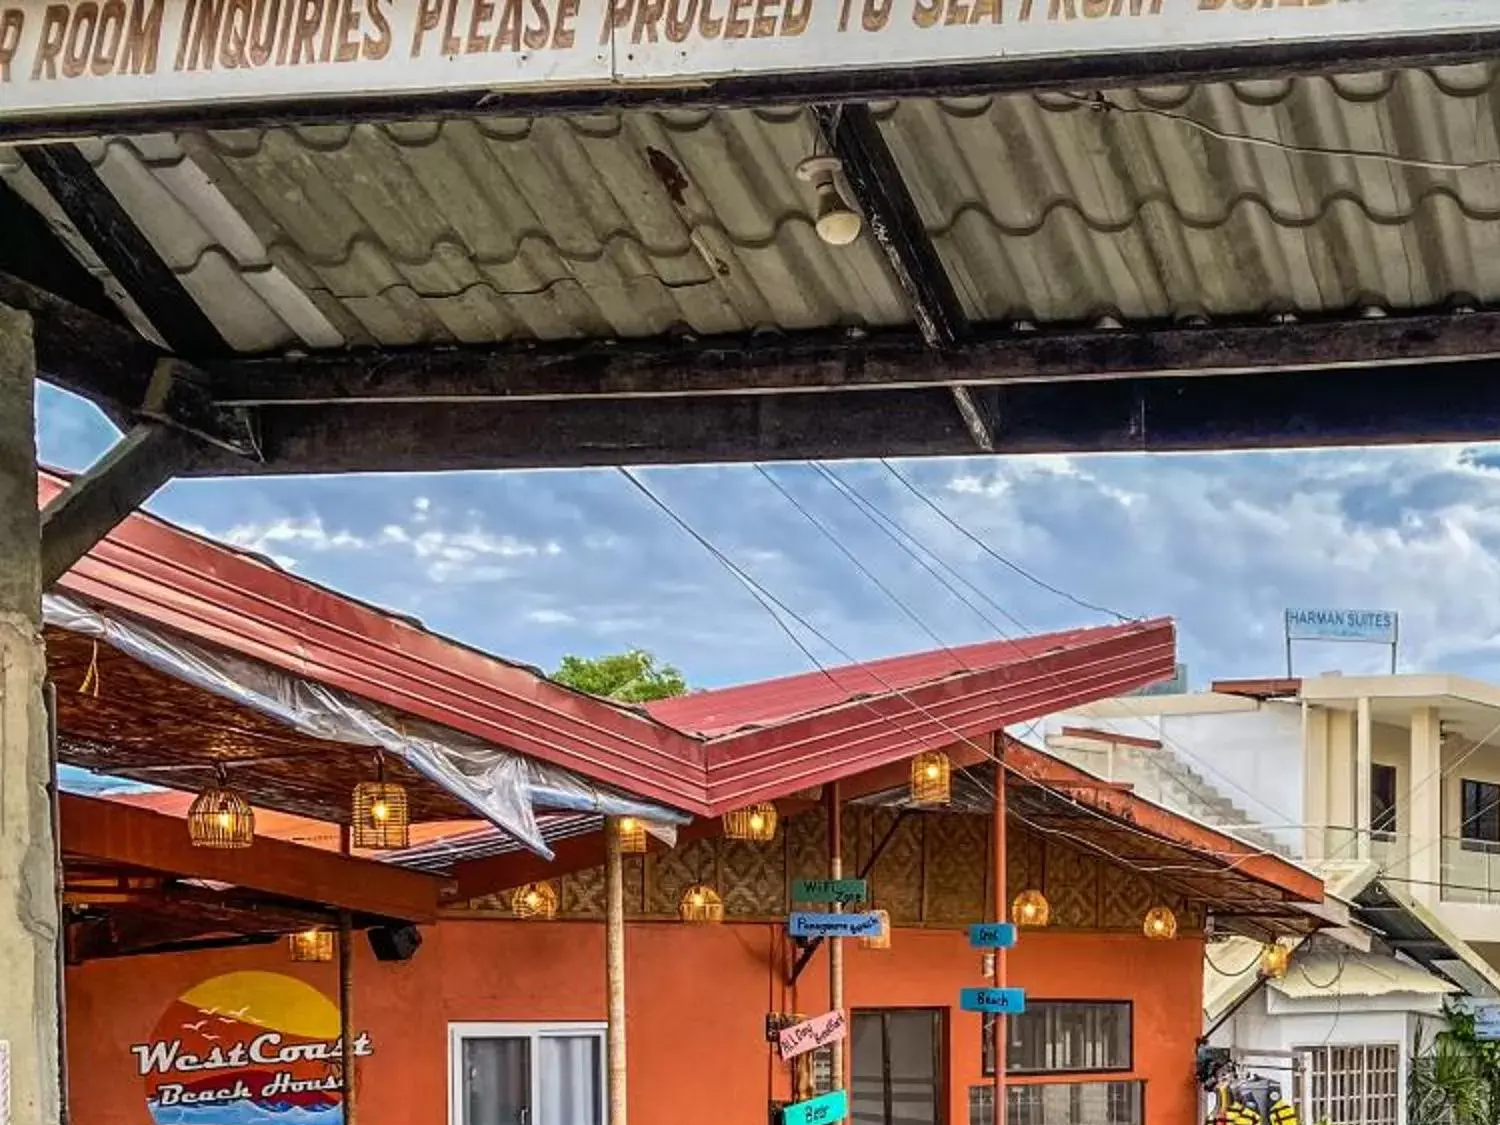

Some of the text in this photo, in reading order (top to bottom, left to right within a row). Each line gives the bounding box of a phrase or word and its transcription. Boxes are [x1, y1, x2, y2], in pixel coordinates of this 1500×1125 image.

[30, 0, 164, 81] ROOM
[173, 0, 393, 71] INQUIRIES
[410, 0, 579, 58] PLEASE
[599, 0, 813, 44] PROCEED
[1289, 610, 1392, 627] HARMAN SUITES
[157, 1080, 252, 1107] Beach
